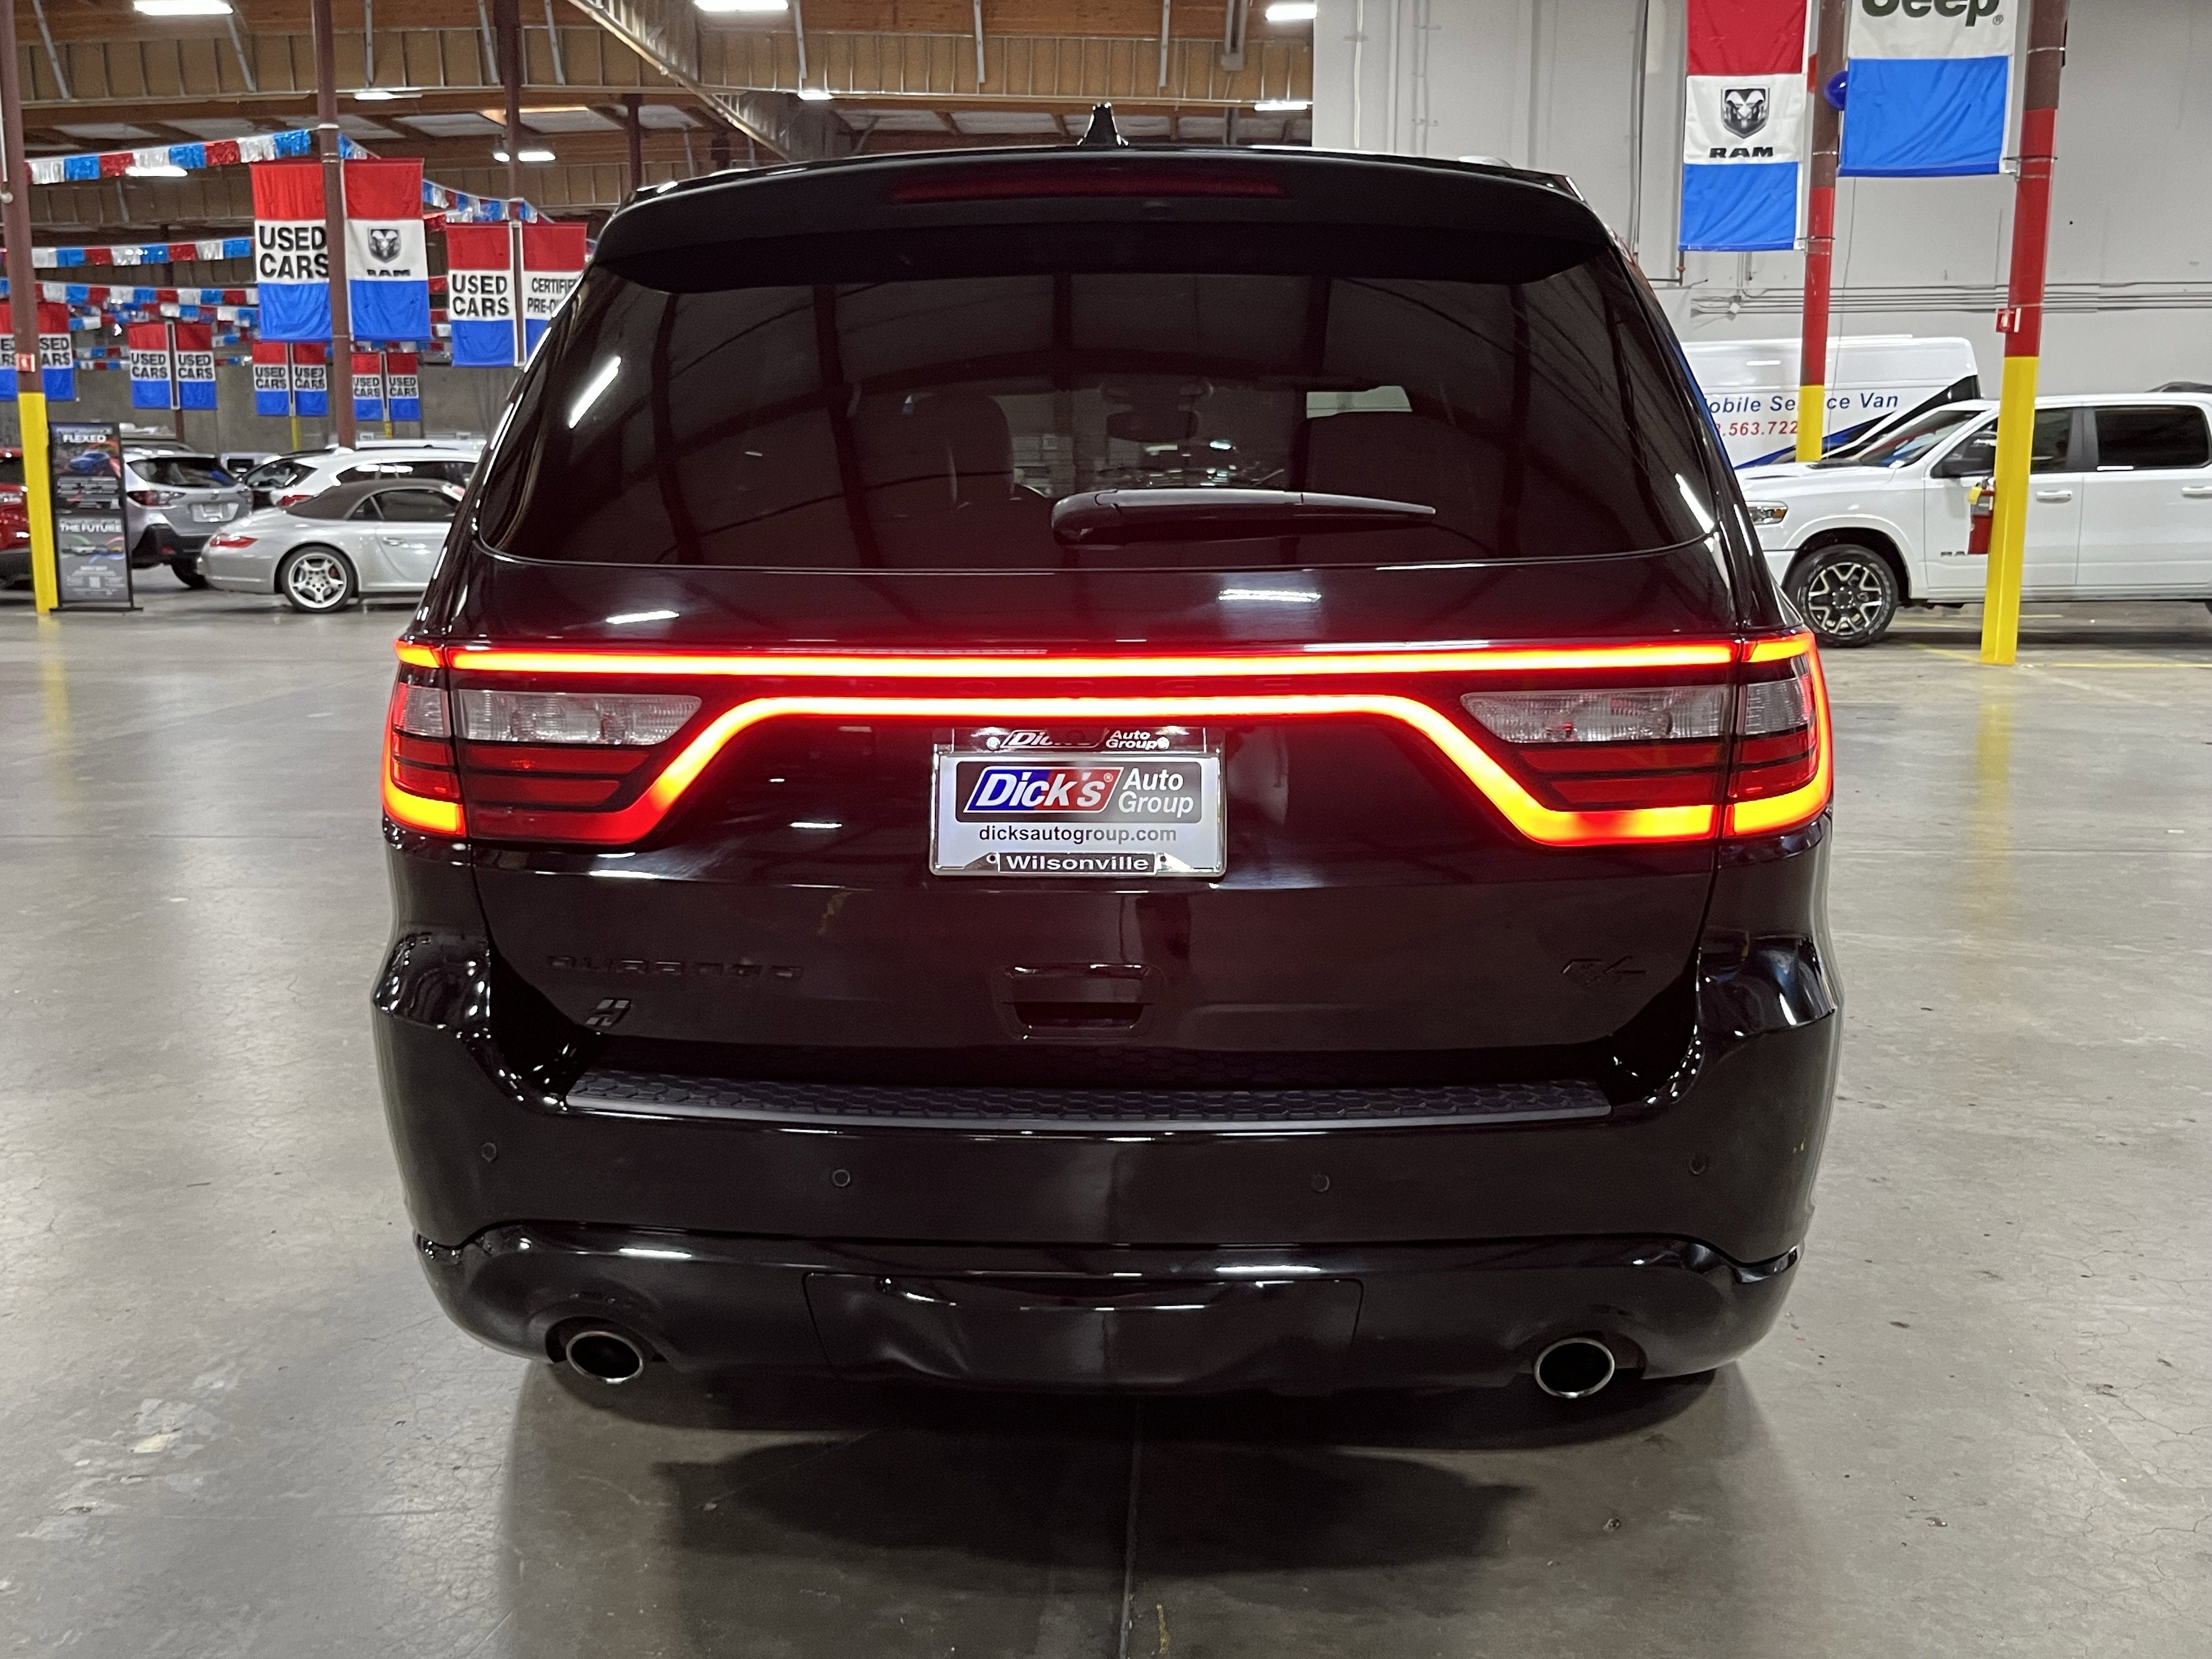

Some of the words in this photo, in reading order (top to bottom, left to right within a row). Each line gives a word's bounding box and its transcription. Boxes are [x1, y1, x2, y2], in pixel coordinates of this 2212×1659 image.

[1709, 146, 1774, 158] RAM
[259, 225, 326, 251] USED
[259, 253, 328, 279] CARS
[452, 274, 507, 295] USED
[453, 296, 510, 317] CARS
[40, 337, 69, 350] SED
[42, 352, 71, 366] ARS
[131, 353, 166, 365] USED
[178, 354, 212, 366] USED
[132, 366, 168, 379] CARS
[178, 367, 213, 379] CARS
[255, 367, 286, 377] USED
[295, 366, 324, 378] USED
[256, 379, 287, 389] CARS
[389, 377, 416, 386] USED
[1705, 396, 1761, 414] obile
[1770, 396, 1850, 411] Sece
[1860, 392, 1898, 408] Van
[1110, 730, 1151, 740] Auto
[1105, 739, 1160, 750] Group
[975, 771, 1105, 807] Dick's
[1122, 768, 1184, 791] Auto
[1118, 791, 1194, 818] Group
[979, 825, 1177, 844] dicksautogroup.com
[1006, 854, 1149, 871] Wilsonville
